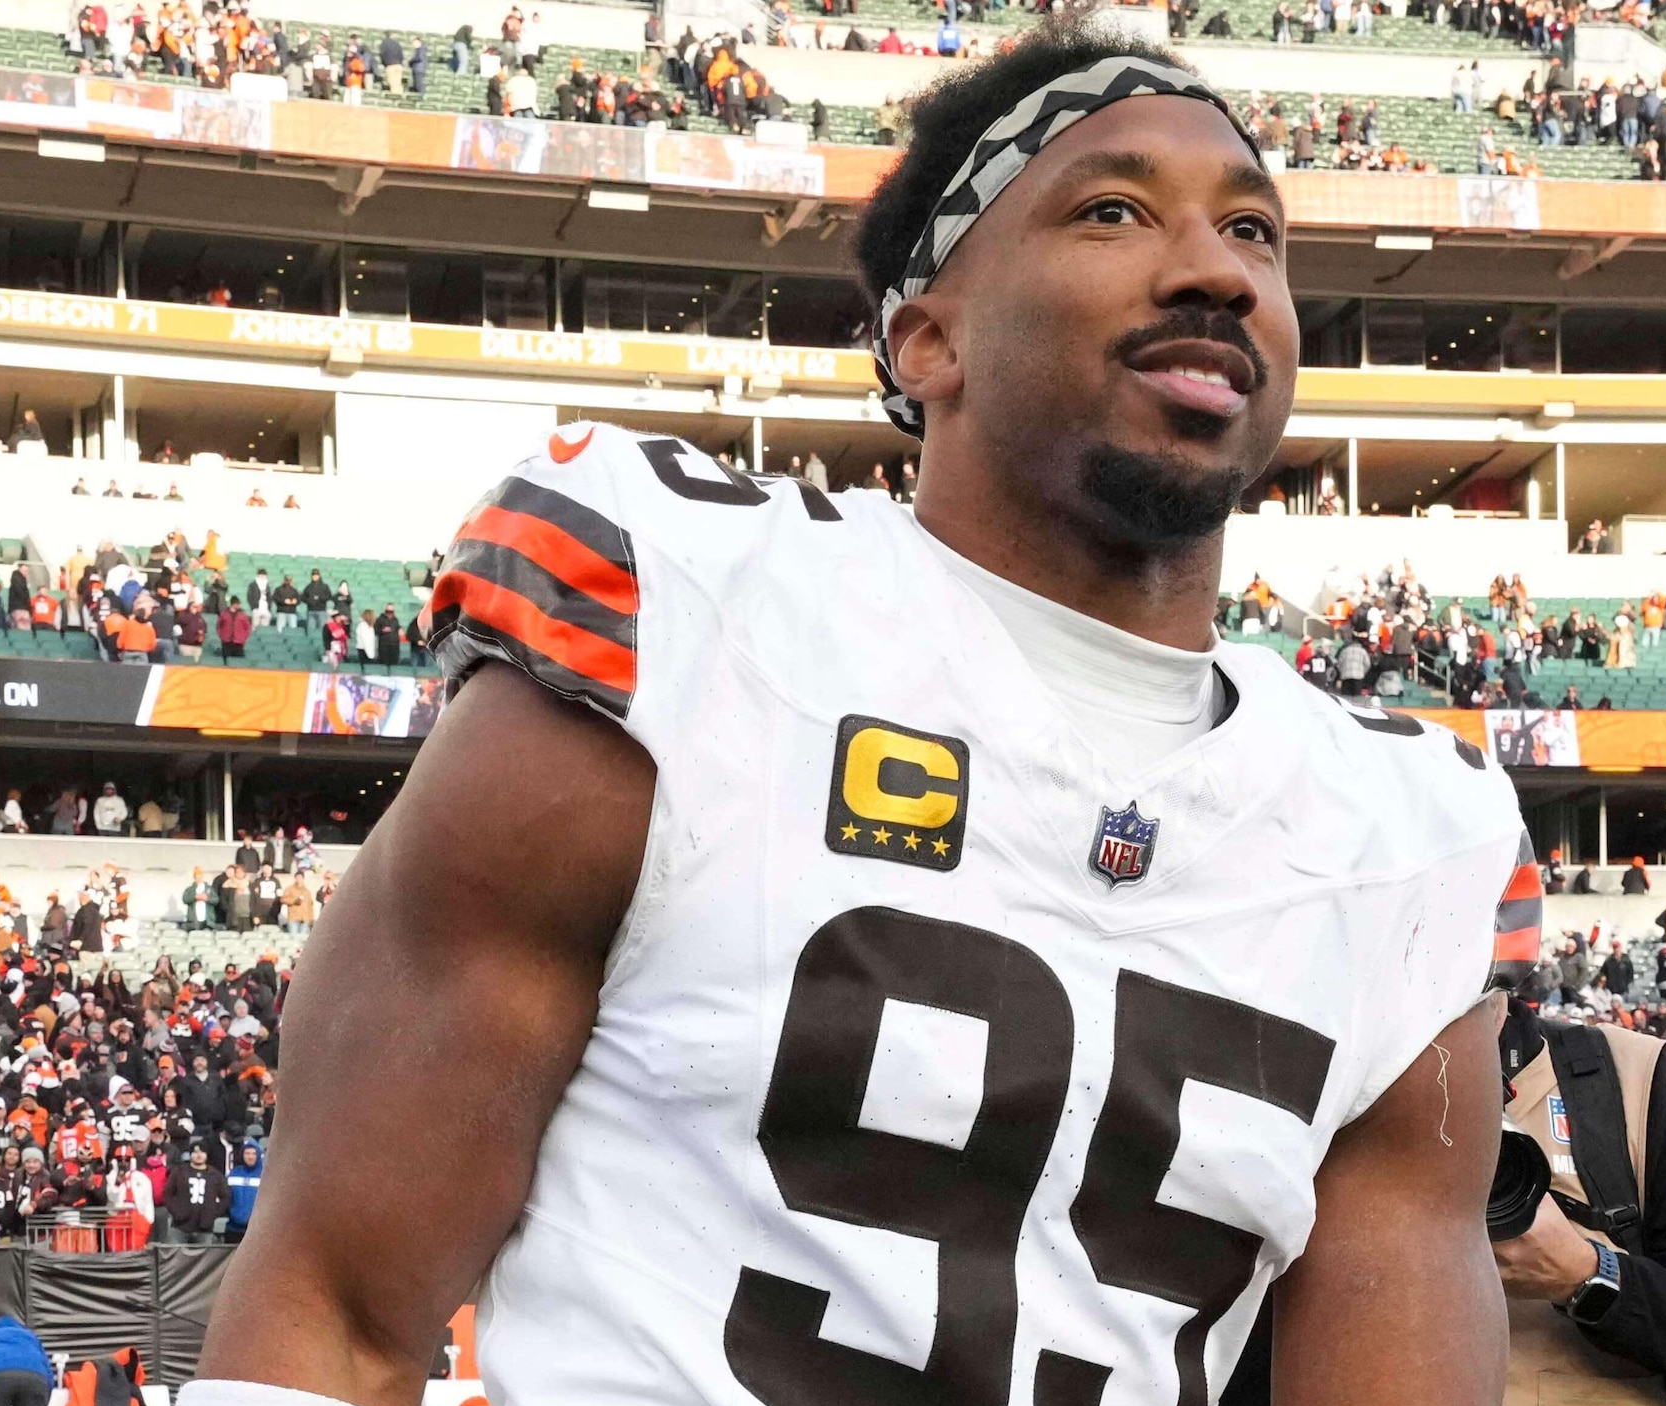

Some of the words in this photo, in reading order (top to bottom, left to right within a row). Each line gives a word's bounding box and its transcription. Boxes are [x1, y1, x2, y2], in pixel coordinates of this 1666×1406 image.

[127, 305, 158, 333] 71
[231, 314, 373, 348] JOHNSON
[480, 329, 583, 362] DILLON
[4, 682, 39, 707] ON
[843, 727, 961, 830] C
[1096, 832, 1145, 879] NFL
